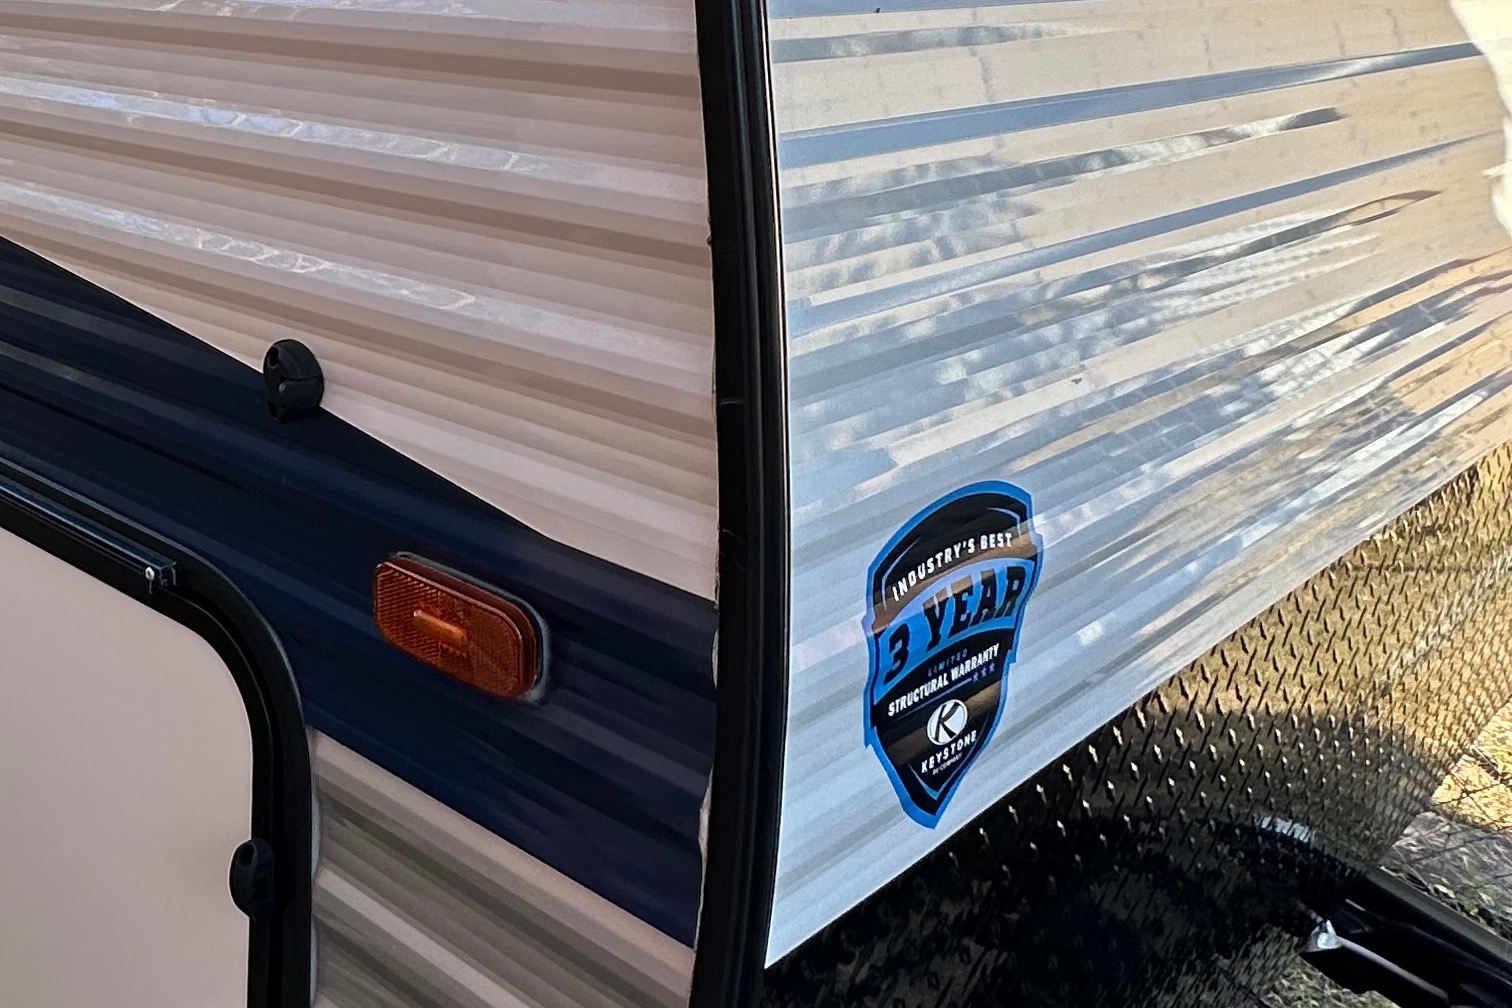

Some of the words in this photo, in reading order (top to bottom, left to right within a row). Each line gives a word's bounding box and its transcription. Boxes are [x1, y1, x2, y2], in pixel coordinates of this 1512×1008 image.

[892, 538, 975, 602] INDUSTRY'S
[980, 532, 1012, 550] BEST
[883, 623, 910, 686] 3
[922, 566, 1026, 653] YEAR
[888, 673, 949, 717] STRUCTURAL
[950, 643, 1000, 681] WARRANTY
[928, 648, 968, 677] LIMITED
[921, 730, 977, 774] KEYSTONE
